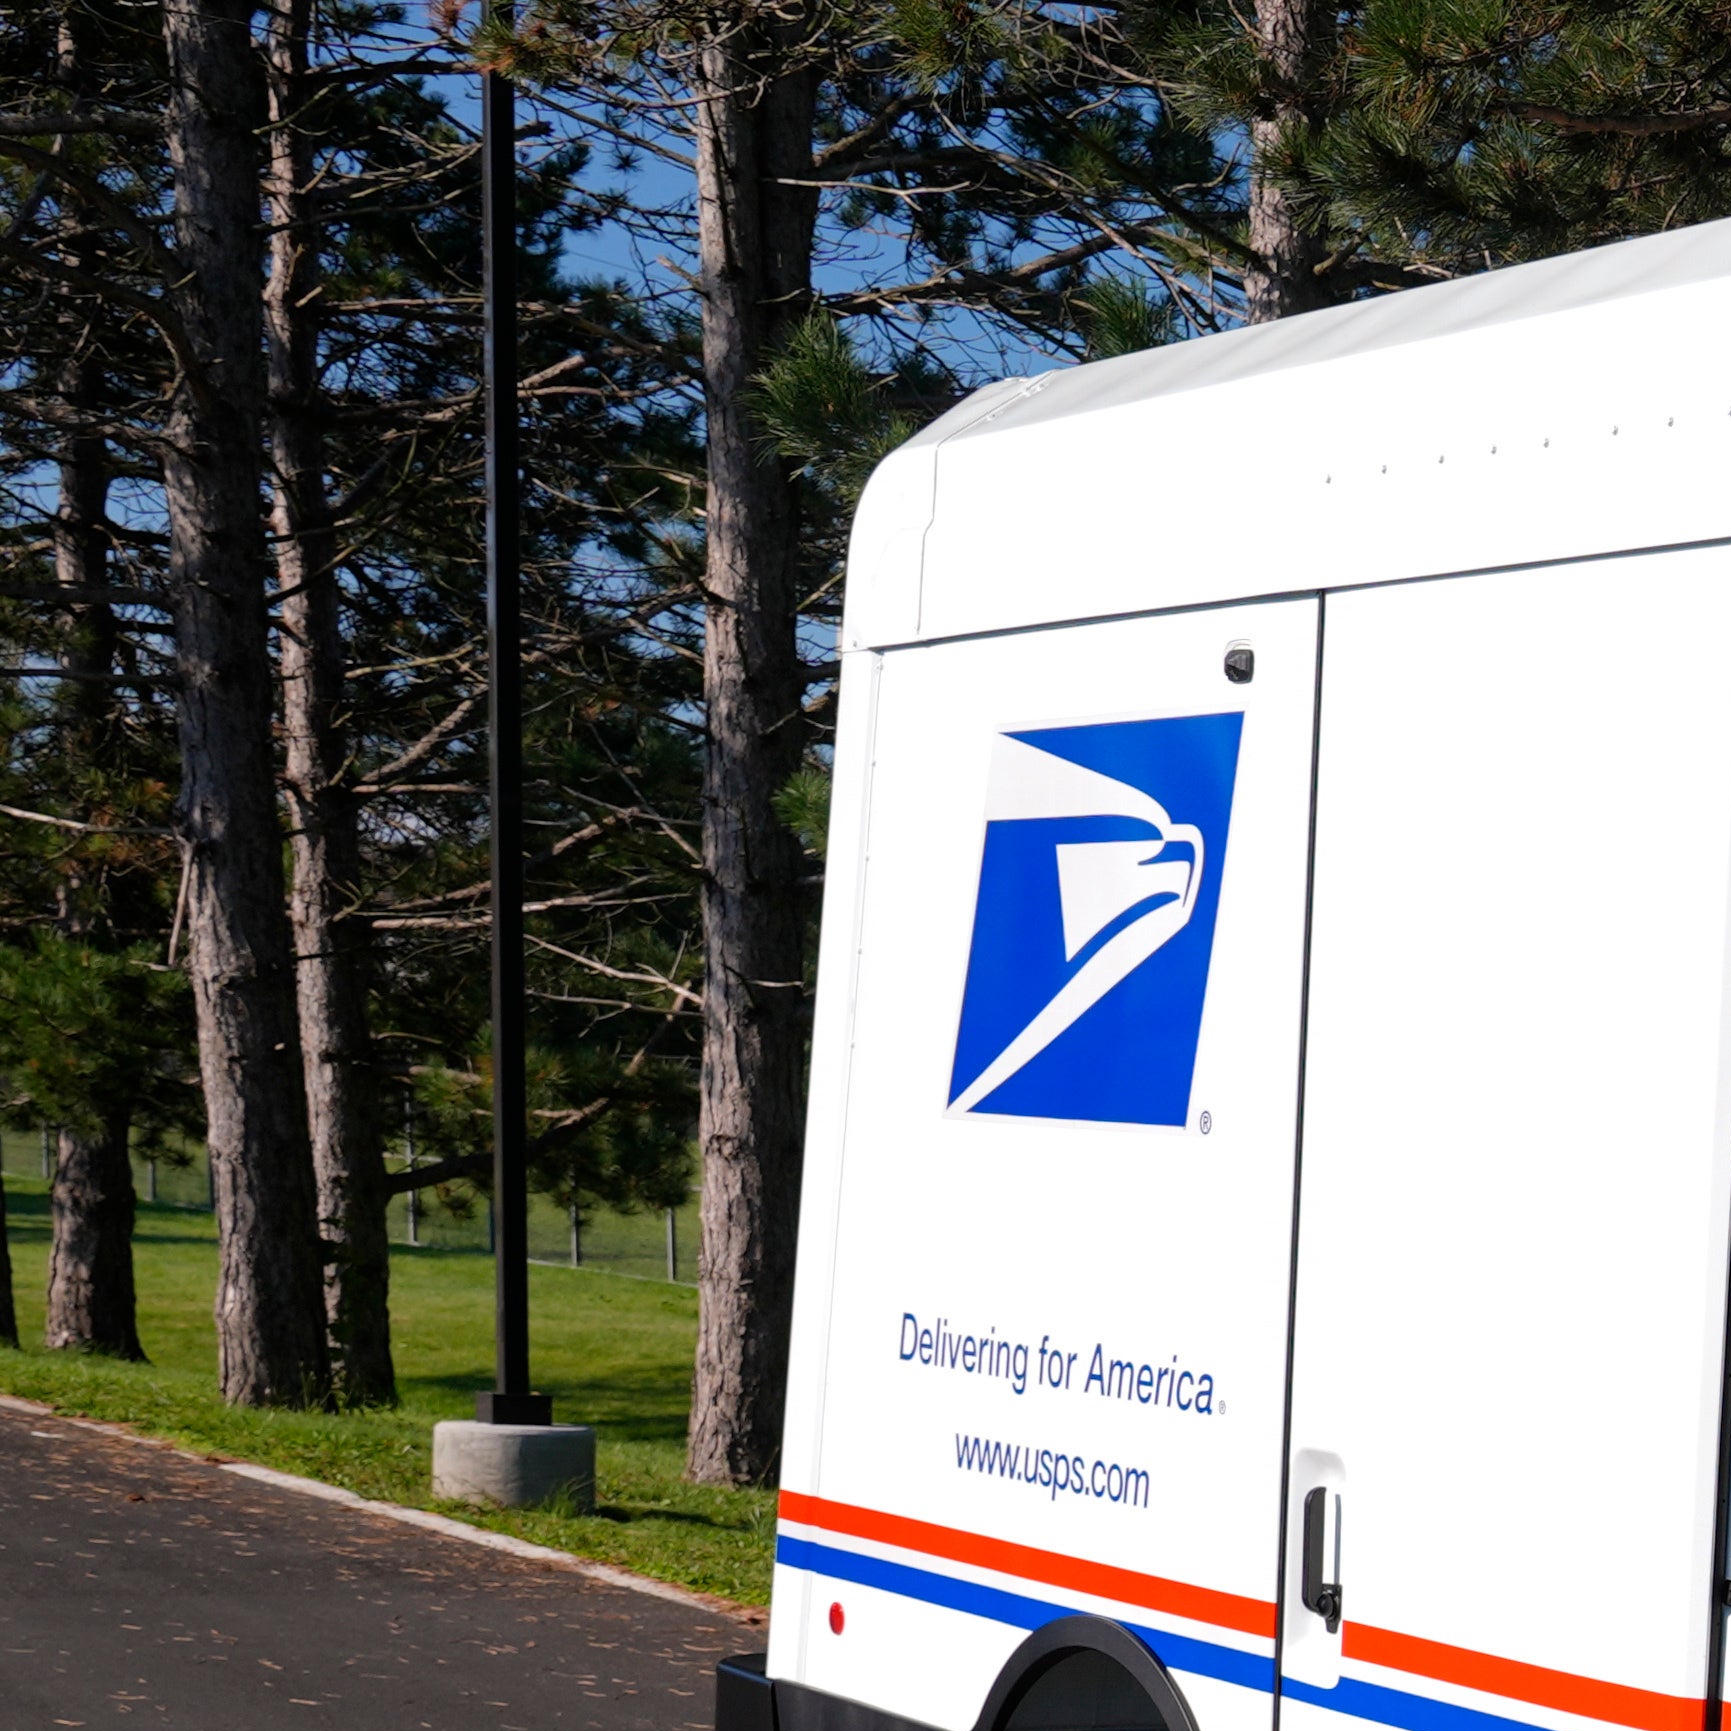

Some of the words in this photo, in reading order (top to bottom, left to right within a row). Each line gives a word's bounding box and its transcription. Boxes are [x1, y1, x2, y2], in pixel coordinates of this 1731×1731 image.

[899, 1312, 1029, 1395] Delivering
[1039, 1335, 1078, 1389] for
[956, 1433, 1150, 1509] www.usps.com
